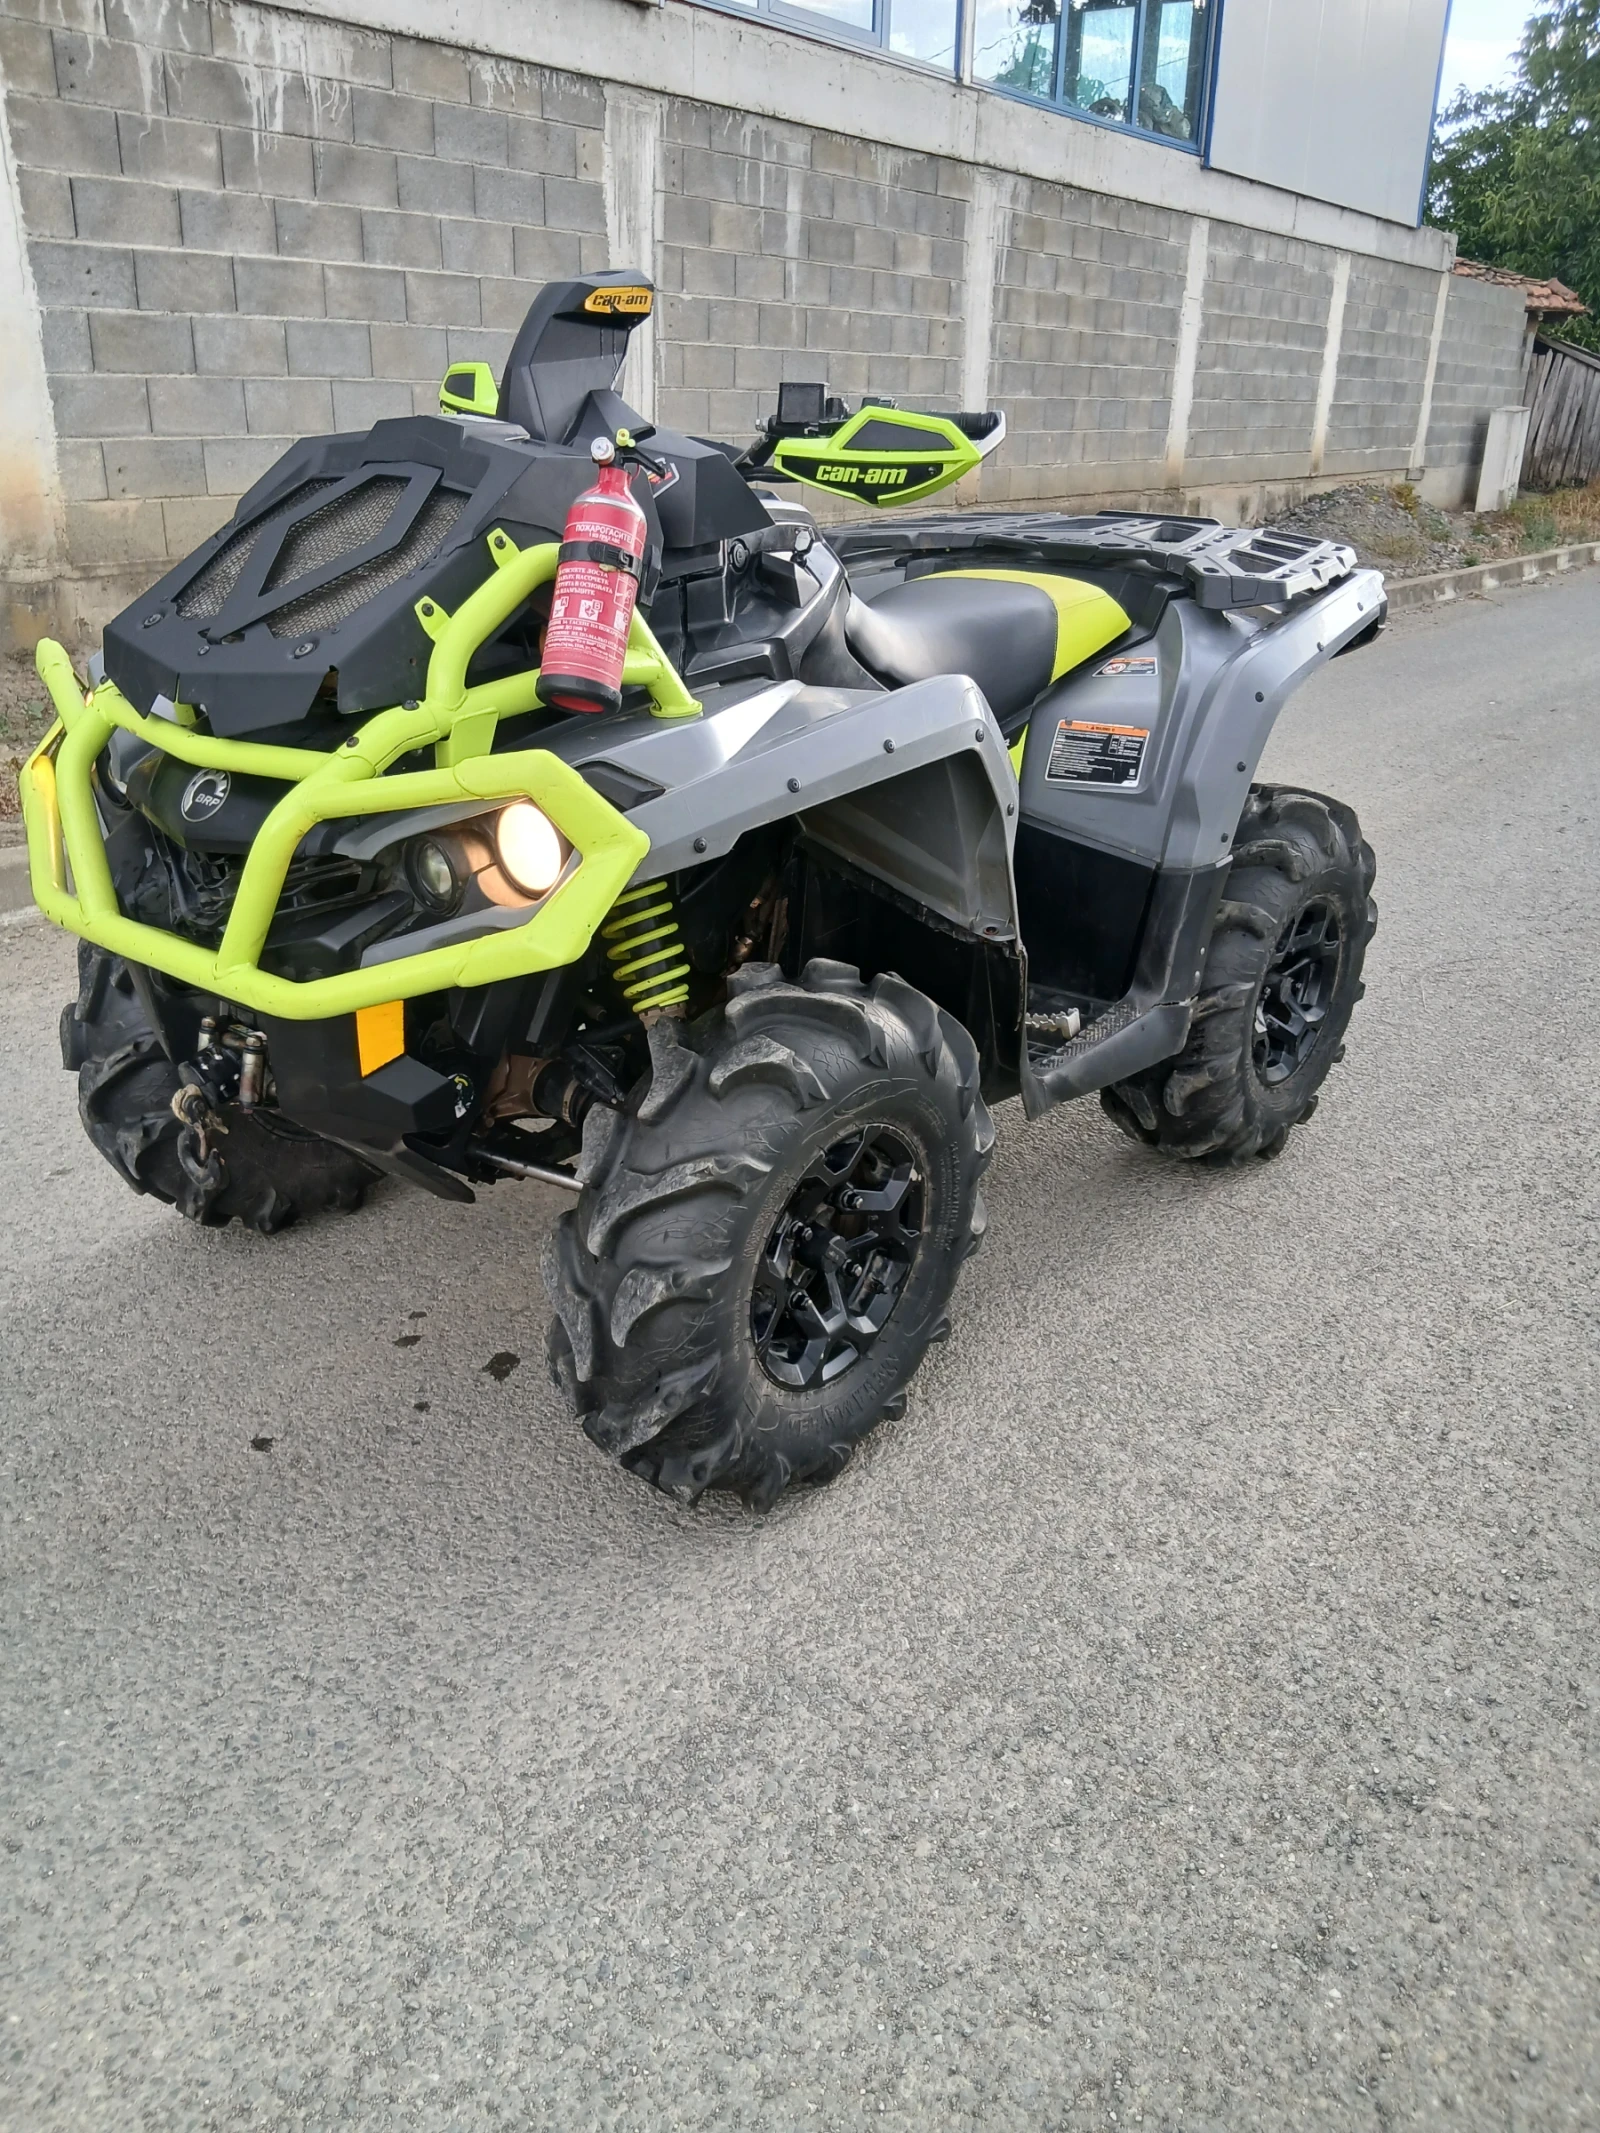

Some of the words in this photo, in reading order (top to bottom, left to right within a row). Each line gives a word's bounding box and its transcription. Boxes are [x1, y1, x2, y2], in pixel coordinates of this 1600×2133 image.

[592, 294, 649, 307] can-am
[815, 464, 908, 485] can-am
[195, 793, 221, 806] BRP
